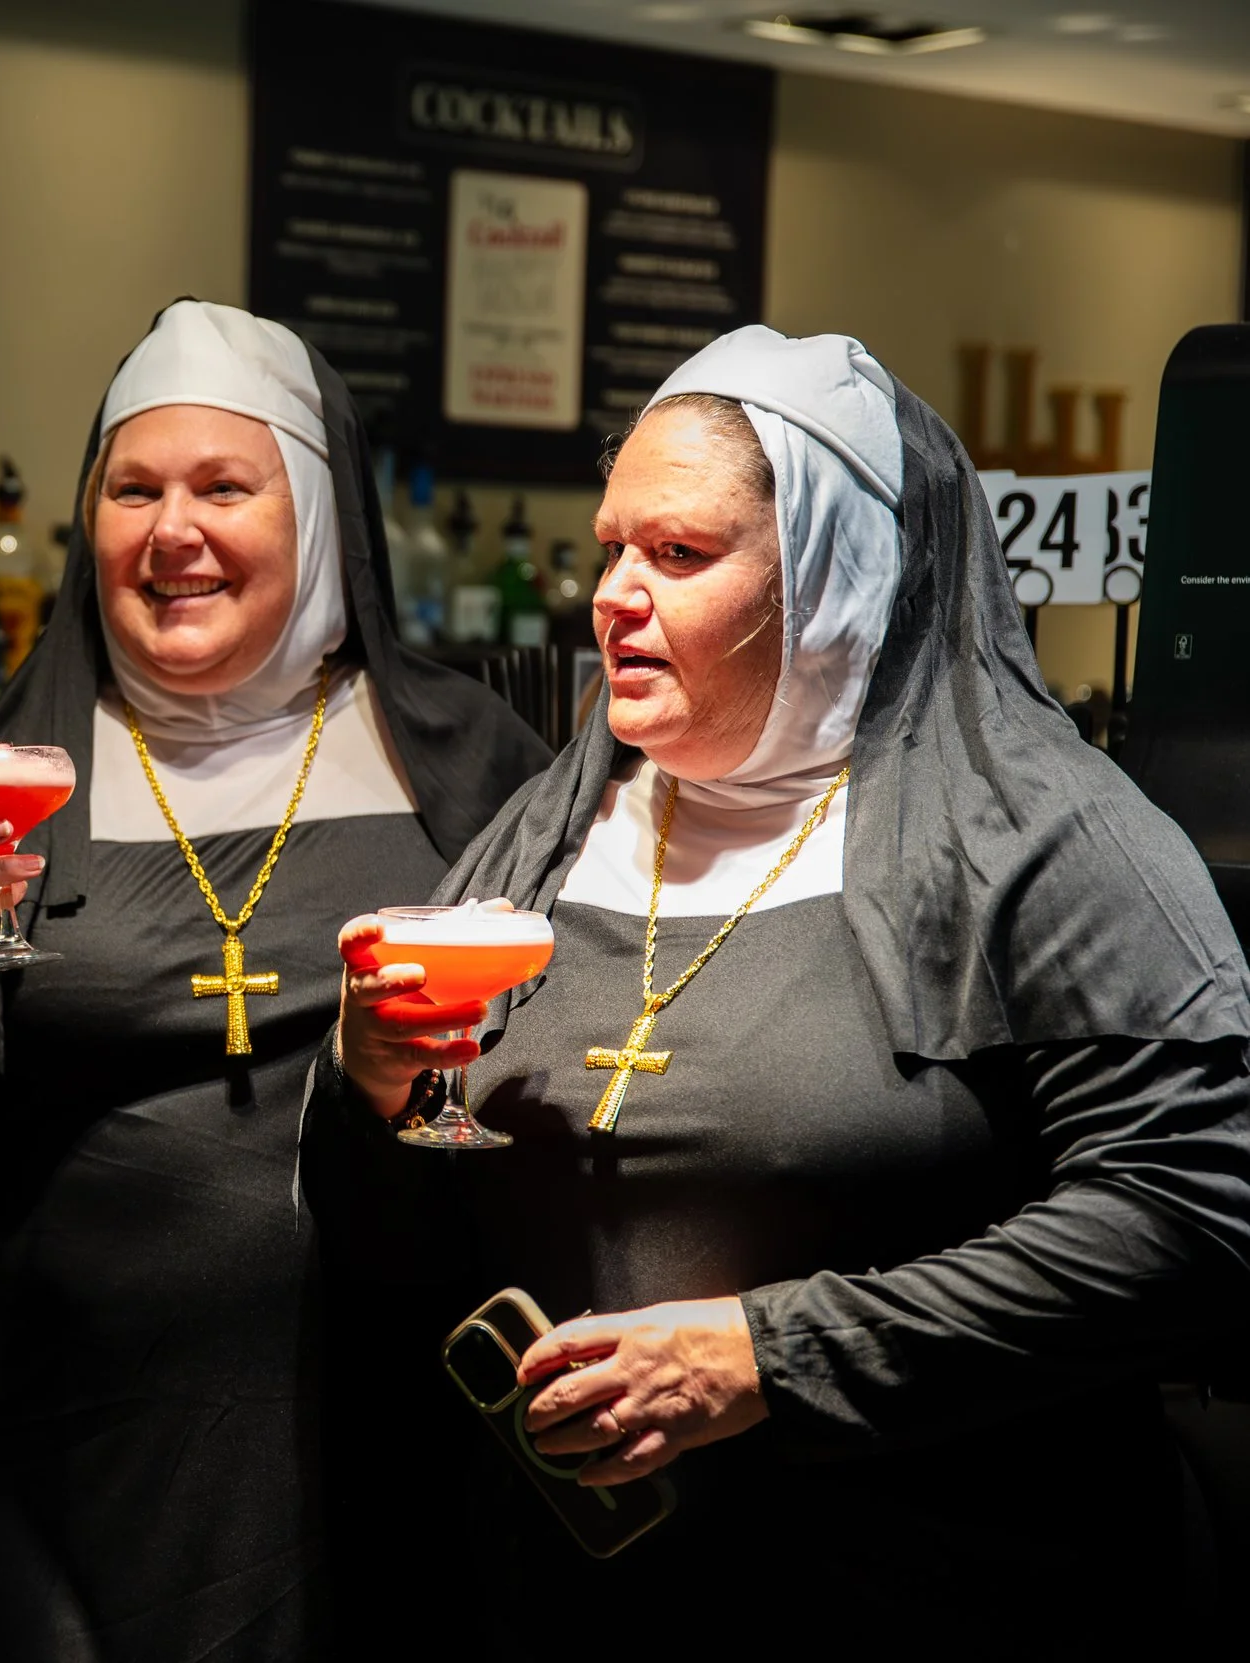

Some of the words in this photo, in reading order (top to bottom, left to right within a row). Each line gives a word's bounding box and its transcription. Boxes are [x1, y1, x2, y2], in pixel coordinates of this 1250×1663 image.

[997, 490, 1080, 569] 24
[1180, 575, 1215, 585] Consider
[1216, 575, 1230, 585] the
